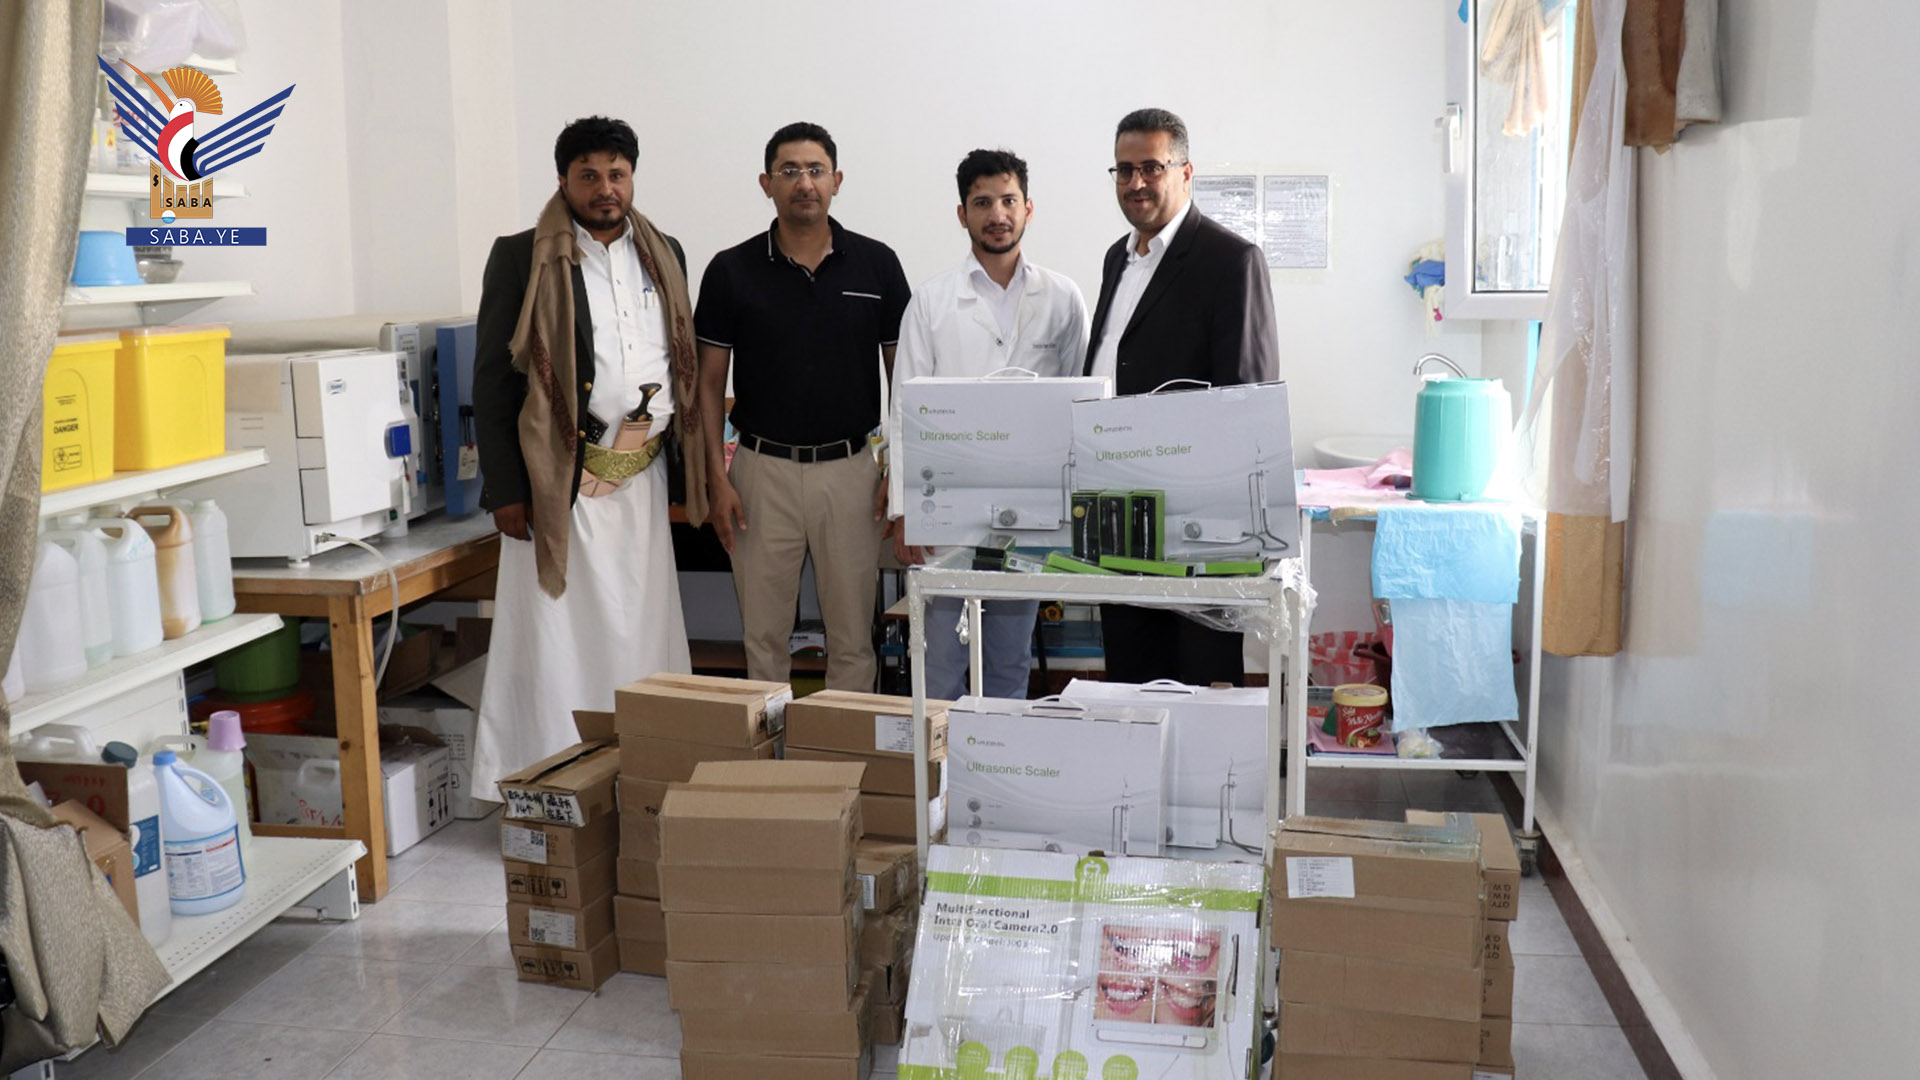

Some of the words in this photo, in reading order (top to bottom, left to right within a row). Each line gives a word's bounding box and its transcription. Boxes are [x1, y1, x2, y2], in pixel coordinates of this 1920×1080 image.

[53, 423, 79, 435] DANGER
[919, 431, 973, 441] Ultrasonic
[976, 430, 1010, 441] Scaler
[1095, 448, 1153, 462] Ultrasonic
[1155, 444, 1192, 457] Scaler
[966, 761, 1022, 775] Ultrasonic
[1025, 765, 1060, 778] Scaler
